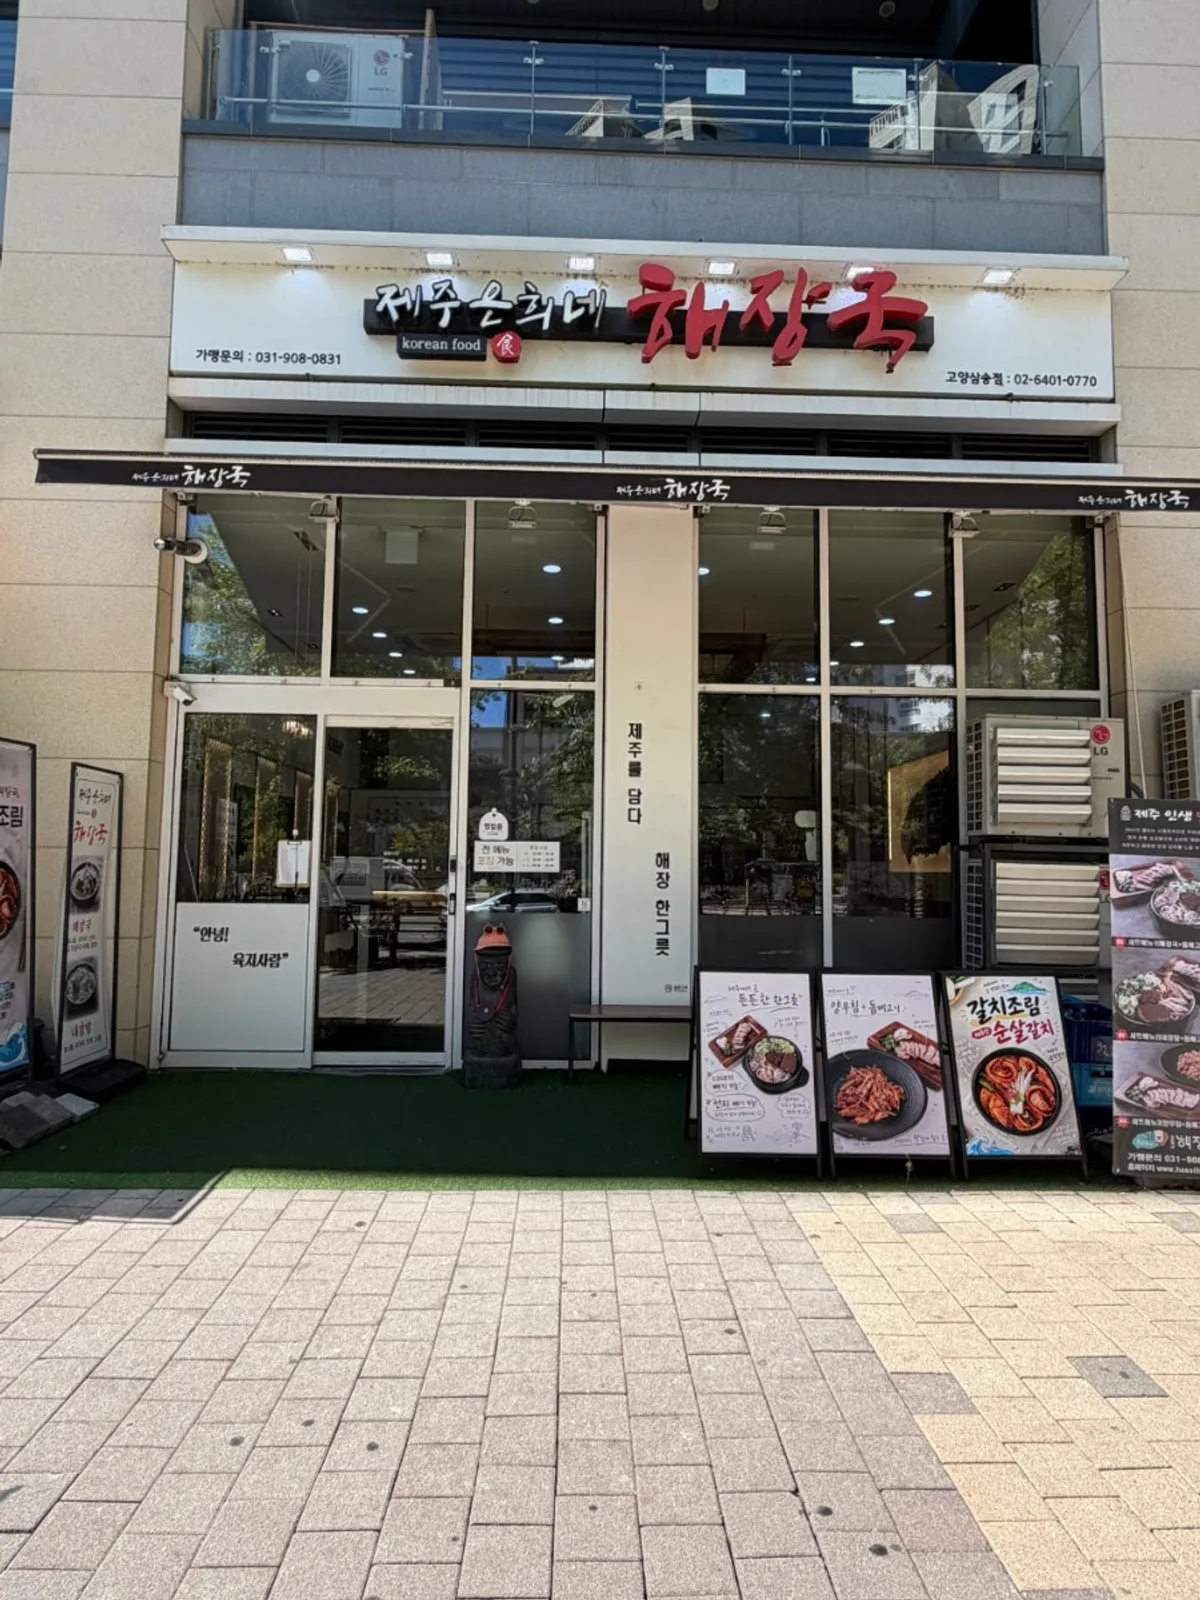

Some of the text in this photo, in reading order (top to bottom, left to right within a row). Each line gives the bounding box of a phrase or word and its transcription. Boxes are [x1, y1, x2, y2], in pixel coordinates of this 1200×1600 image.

[374, 67, 388, 76] LG
[627, 263, 928, 372] 해장국
[402, 337, 482, 351] korean food
[496, 334, 515, 356] 食
[196, 350, 244, 362] 가맹문의
[255, 352, 342, 365] 031-908-0831
[945, 371, 1004, 386] 고양삼송점
[1014, 374, 1098, 387] 02-6401-0770
[181, 465, 251, 487] 해장국
[663, 478, 731, 501] 해장국
[1124, 489, 1190, 509] 해장국
[1093, 747, 1109, 756] LG
[628, 723, 642, 824] 제주를 담다
[1134, 808, 1161, 820] 제주
[1164, 809, 1193, 822] 인생
[74, 820, 108, 846] 해장국
[496, 857, 514, 867] 가능
[655, 852, 670, 956] 해장 한그릇
[738, 993, 770, 1007] 든든한
[966, 996, 1041, 1025] 갈치조림
[993, 1018, 1055, 1044] 순살갈치
